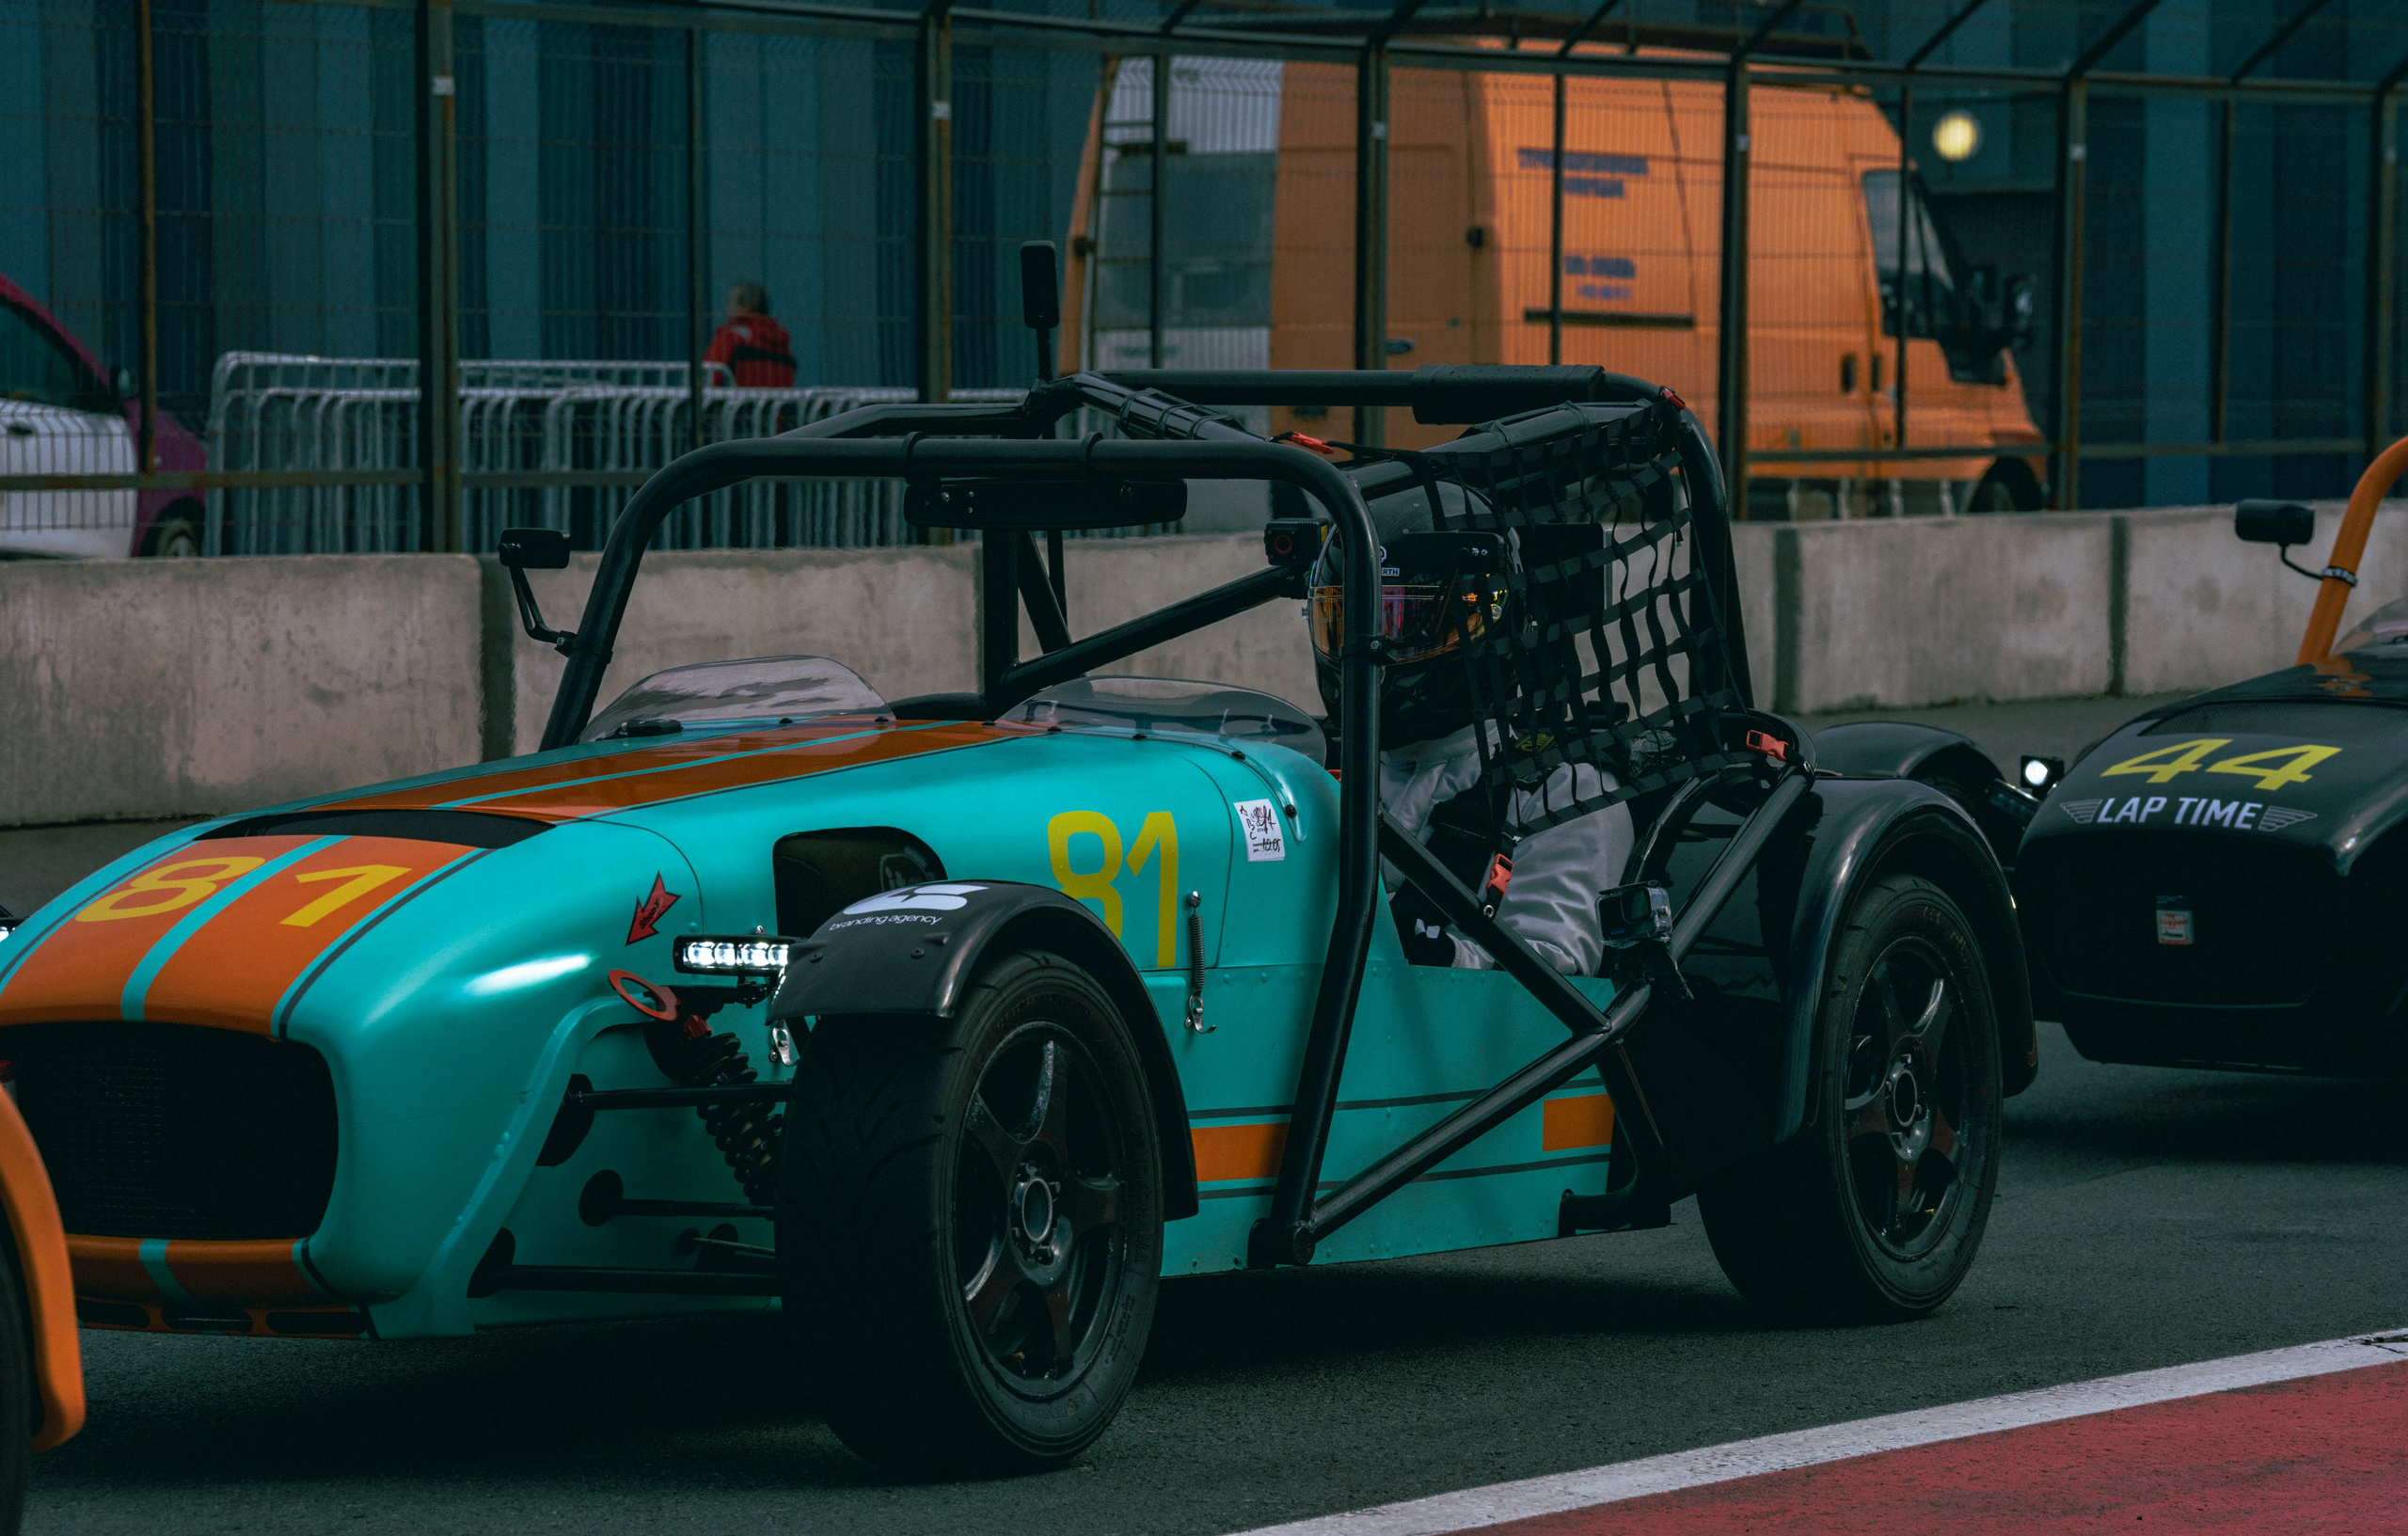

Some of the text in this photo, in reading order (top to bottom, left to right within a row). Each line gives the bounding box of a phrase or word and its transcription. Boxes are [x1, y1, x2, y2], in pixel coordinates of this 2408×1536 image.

[2099, 738, 2343, 791] 44
[2097, 796, 2264, 831] LAP TIME
[74, 856, 414, 927] 81
[1047, 810, 1179, 969] 81
[829, 915, 943, 930] branding agency
